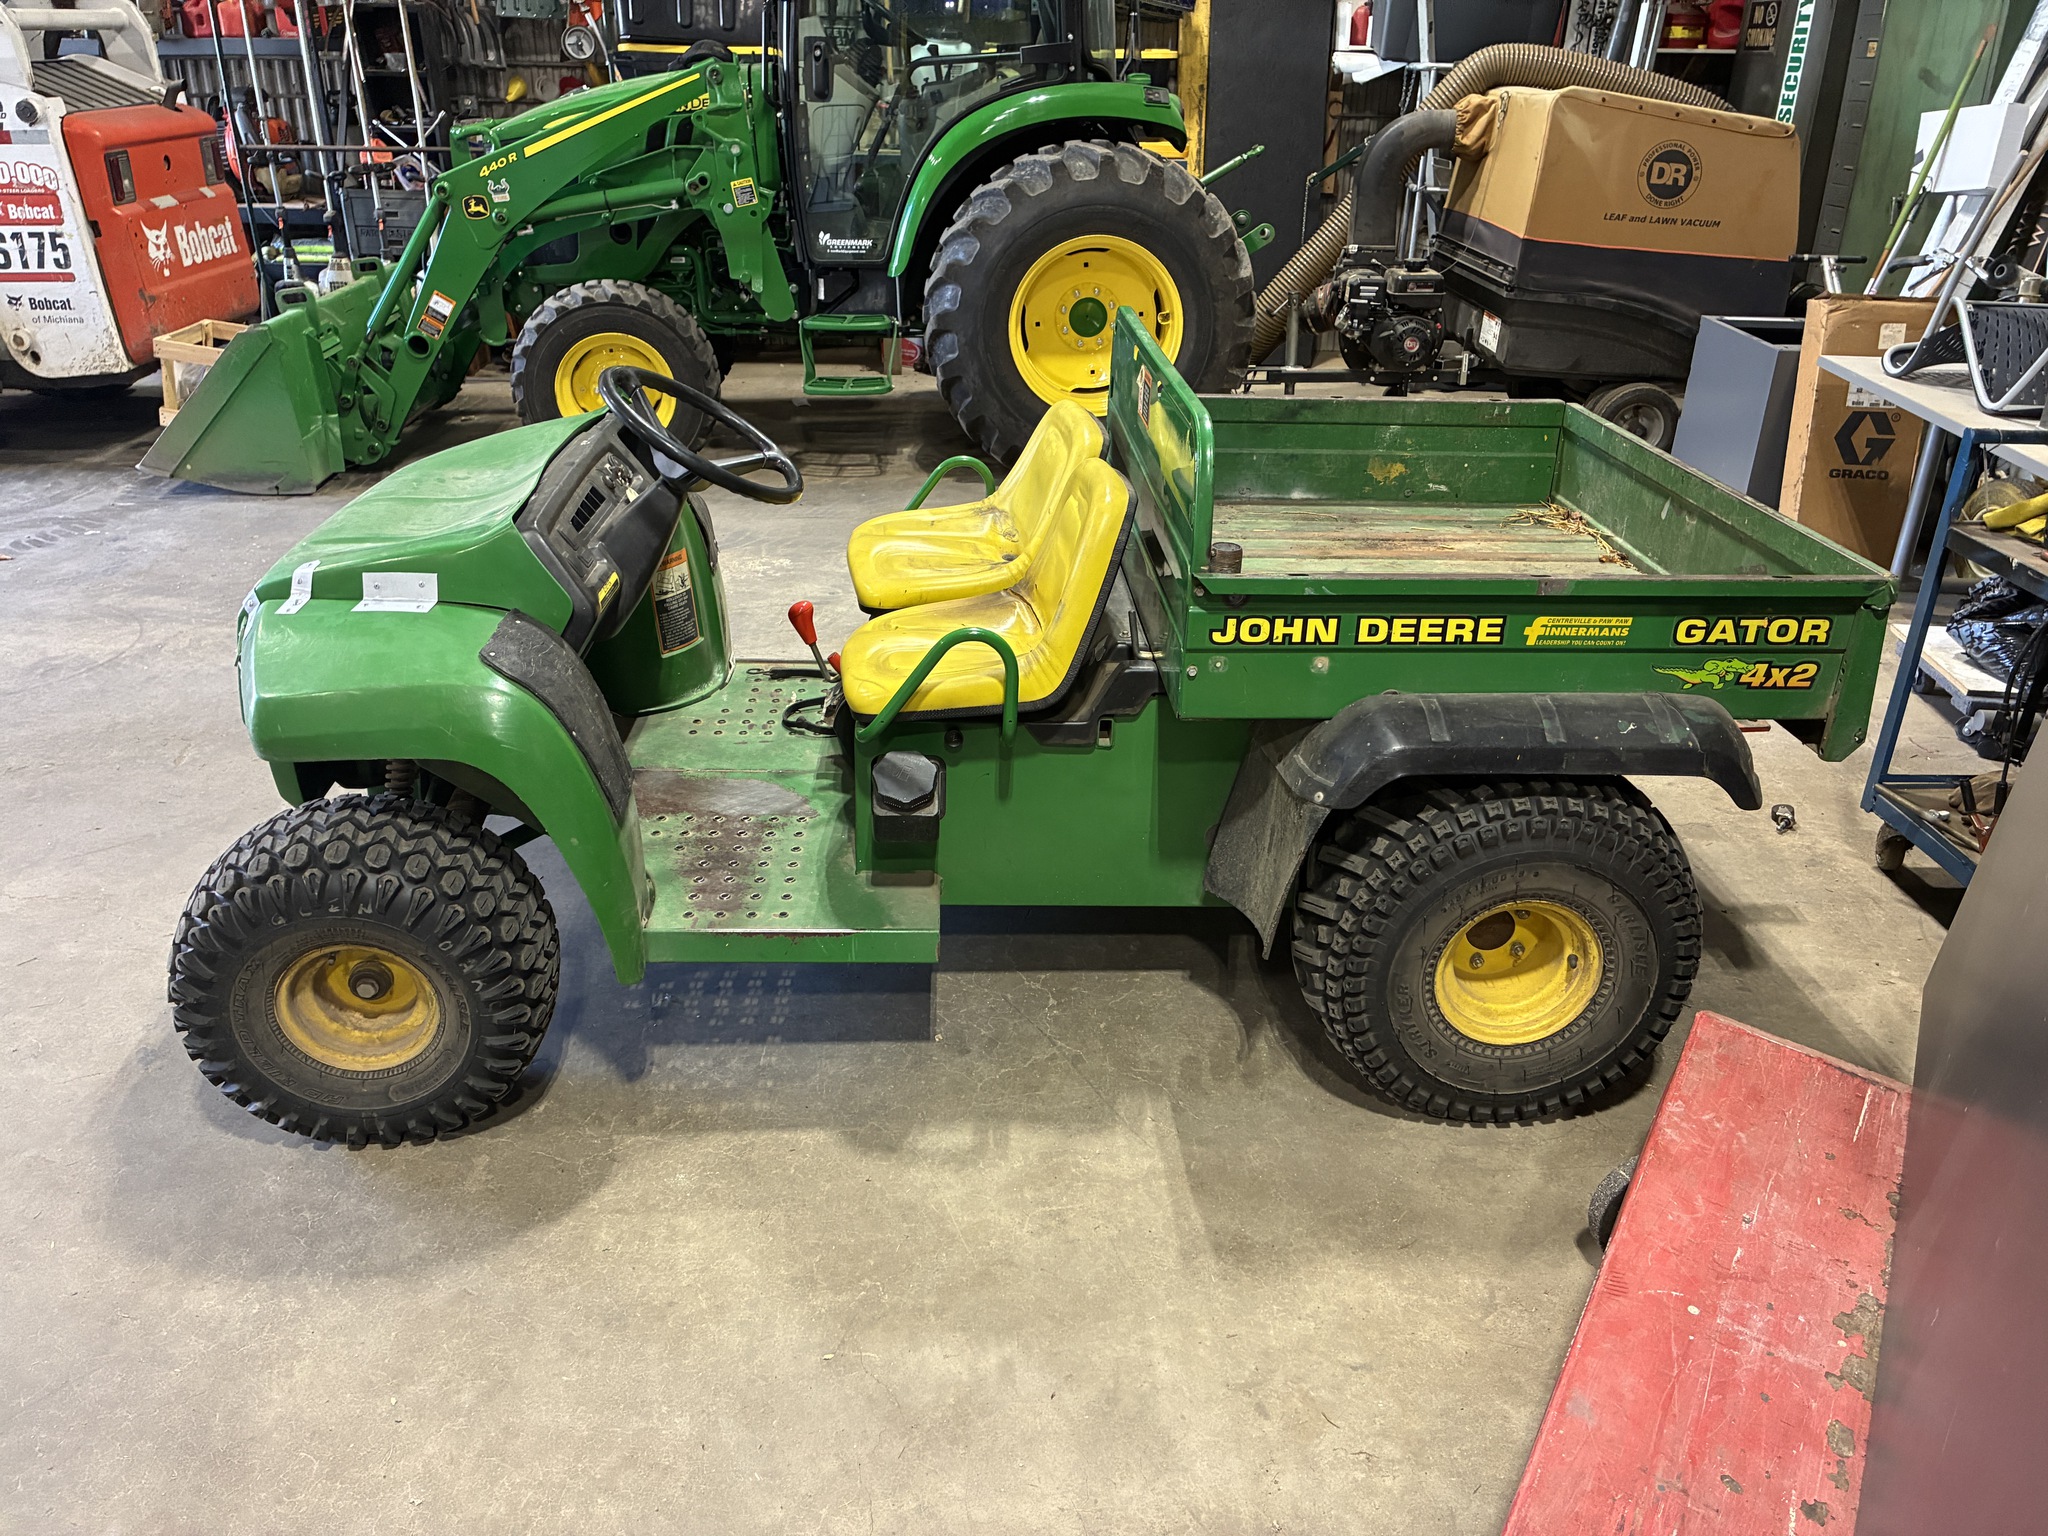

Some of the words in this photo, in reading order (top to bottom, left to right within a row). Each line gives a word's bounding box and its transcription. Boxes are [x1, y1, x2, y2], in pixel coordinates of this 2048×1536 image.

[1753, 5, 1765, 25] NO
[1745, 27, 1776, 48] SMOKING
[1777, 0, 1814, 123] SECURITY
[1642, 142, 1686, 167] PROFESSIONAL
[1687, 149, 1700, 171] POWER
[1649, 161, 1688, 187] DR
[7, 203, 56, 220] Bobcat
[1646, 193, 1663, 207] DONE
[1663, 196, 1685, 207] RIGHT
[1603, 212, 1628, 222] LEAF
[1628, 215, 1648, 223] and
[1649, 216, 1678, 225] LAWN
[1680, 218, 1721, 228] VACUUM
[173, 215, 238, 268] Bobcat
[826, 238, 873, 247] GREENMARK
[28, 297, 73, 311] Bobcat
[31, 315, 41, 324] of
[43, 315, 85, 324] Michiana
[1828, 468, 1889, 481] GRACO
[1211, 617, 1339, 644] JOHN
[1356, 617, 1505, 644] DEERE
[1675, 618, 1831, 644] GATOR
[1738, 662, 1819, 688] 4x2
[1606, 894, 1648, 976] CARLISLE
[234, 959, 261, 1023] TRAX
[420, 953, 470, 1033] CARLISLE
[238, 1029, 297, 1088] FIELD
